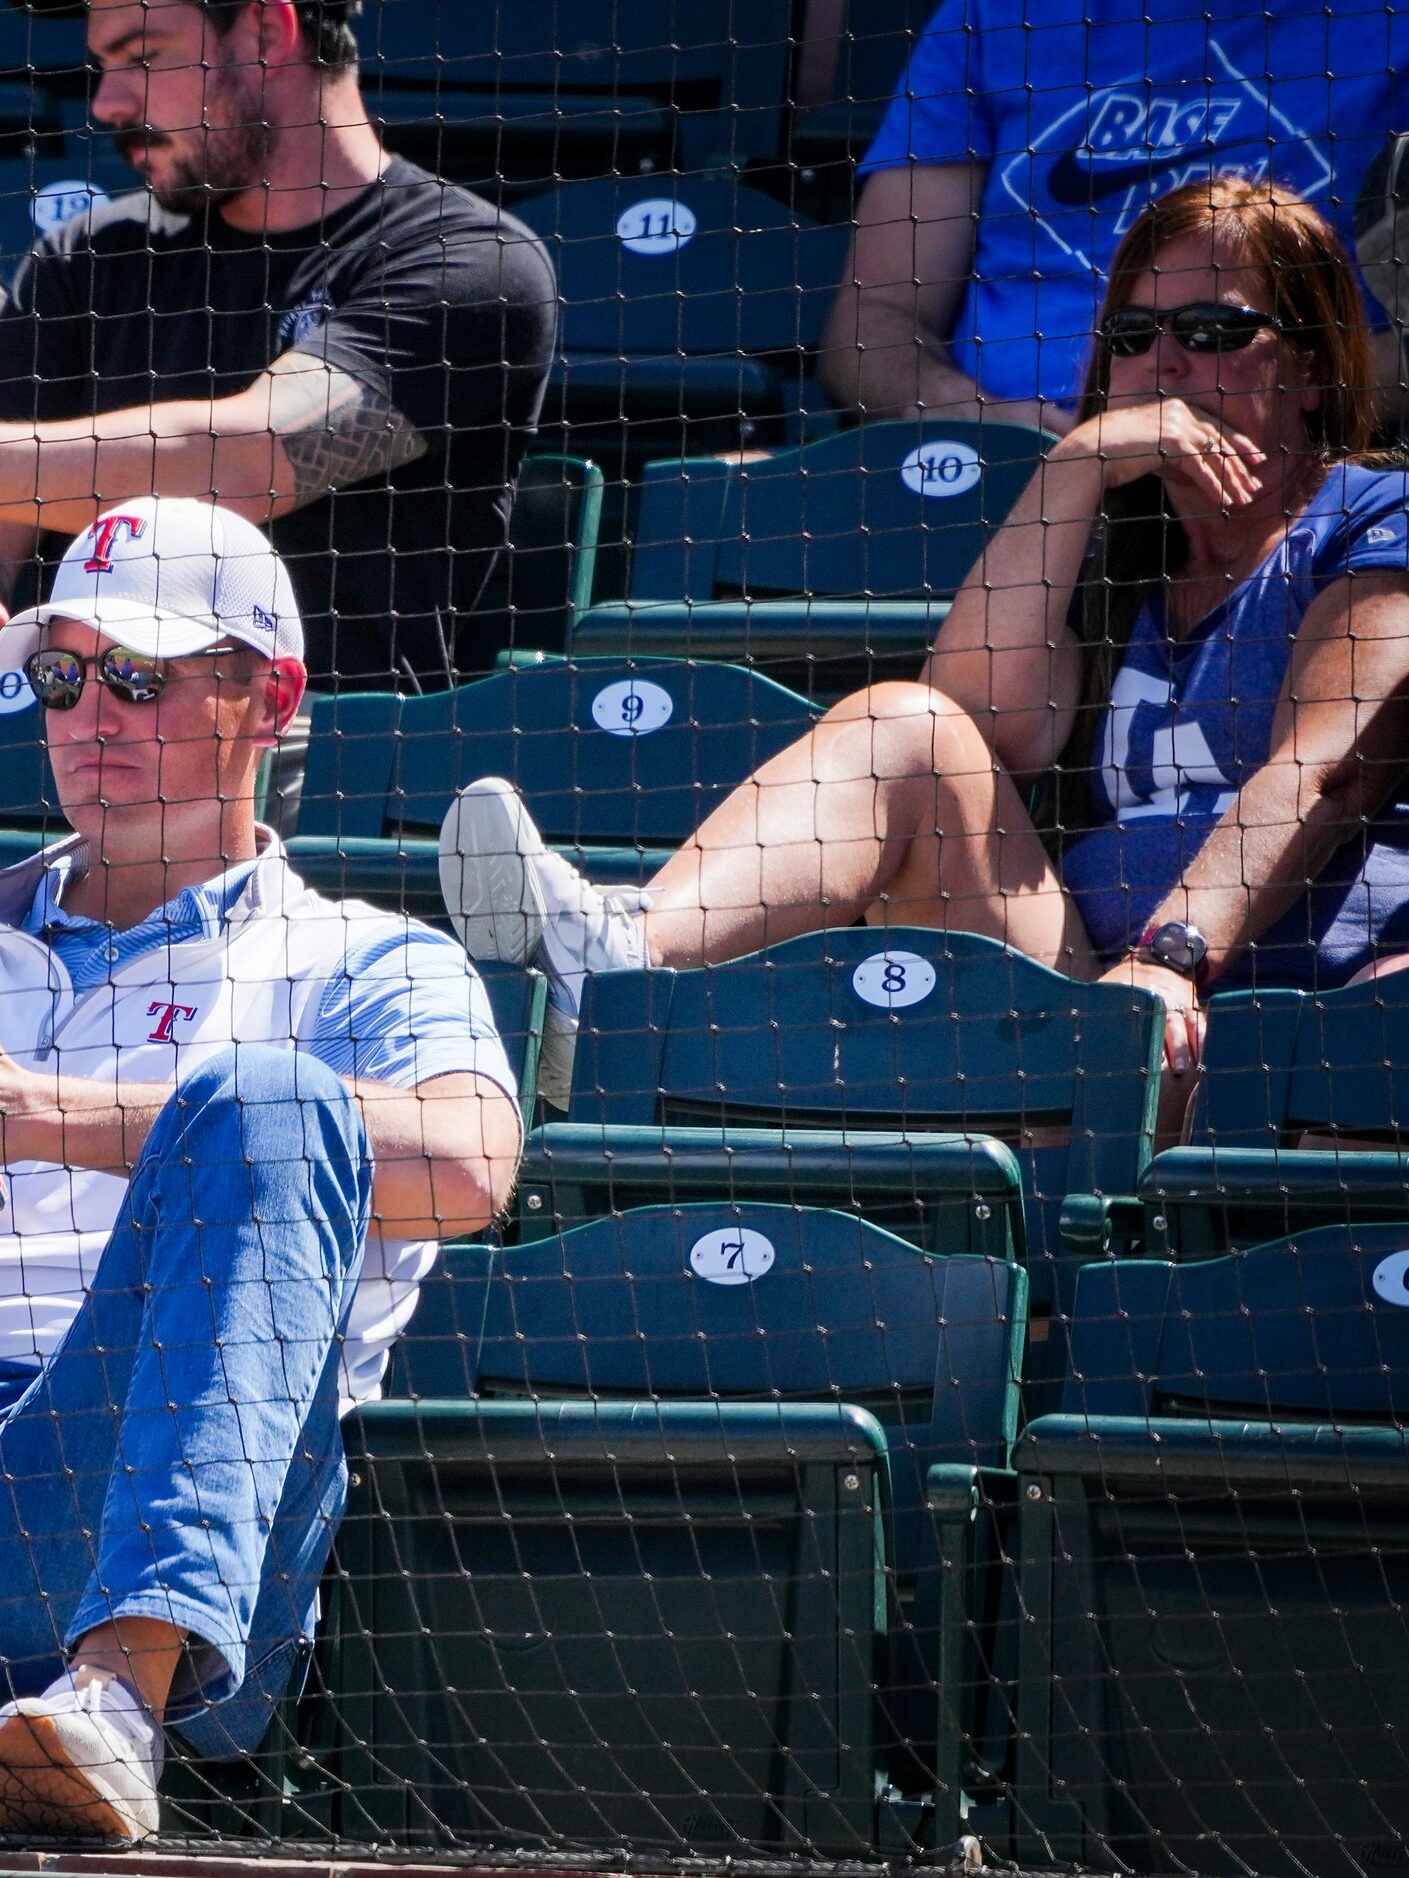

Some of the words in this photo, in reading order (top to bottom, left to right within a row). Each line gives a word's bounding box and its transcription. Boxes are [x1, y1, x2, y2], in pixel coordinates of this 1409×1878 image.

[1076, 93, 1241, 160] BASE
[639, 213, 671, 239] 11
[923, 455, 963, 483] 10
[83, 515, 148, 574] T
[621, 694, 644, 723] 9
[881, 963, 906, 993] 8
[146, 1001, 199, 1044] T
[720, 1242, 745, 1270] 7
